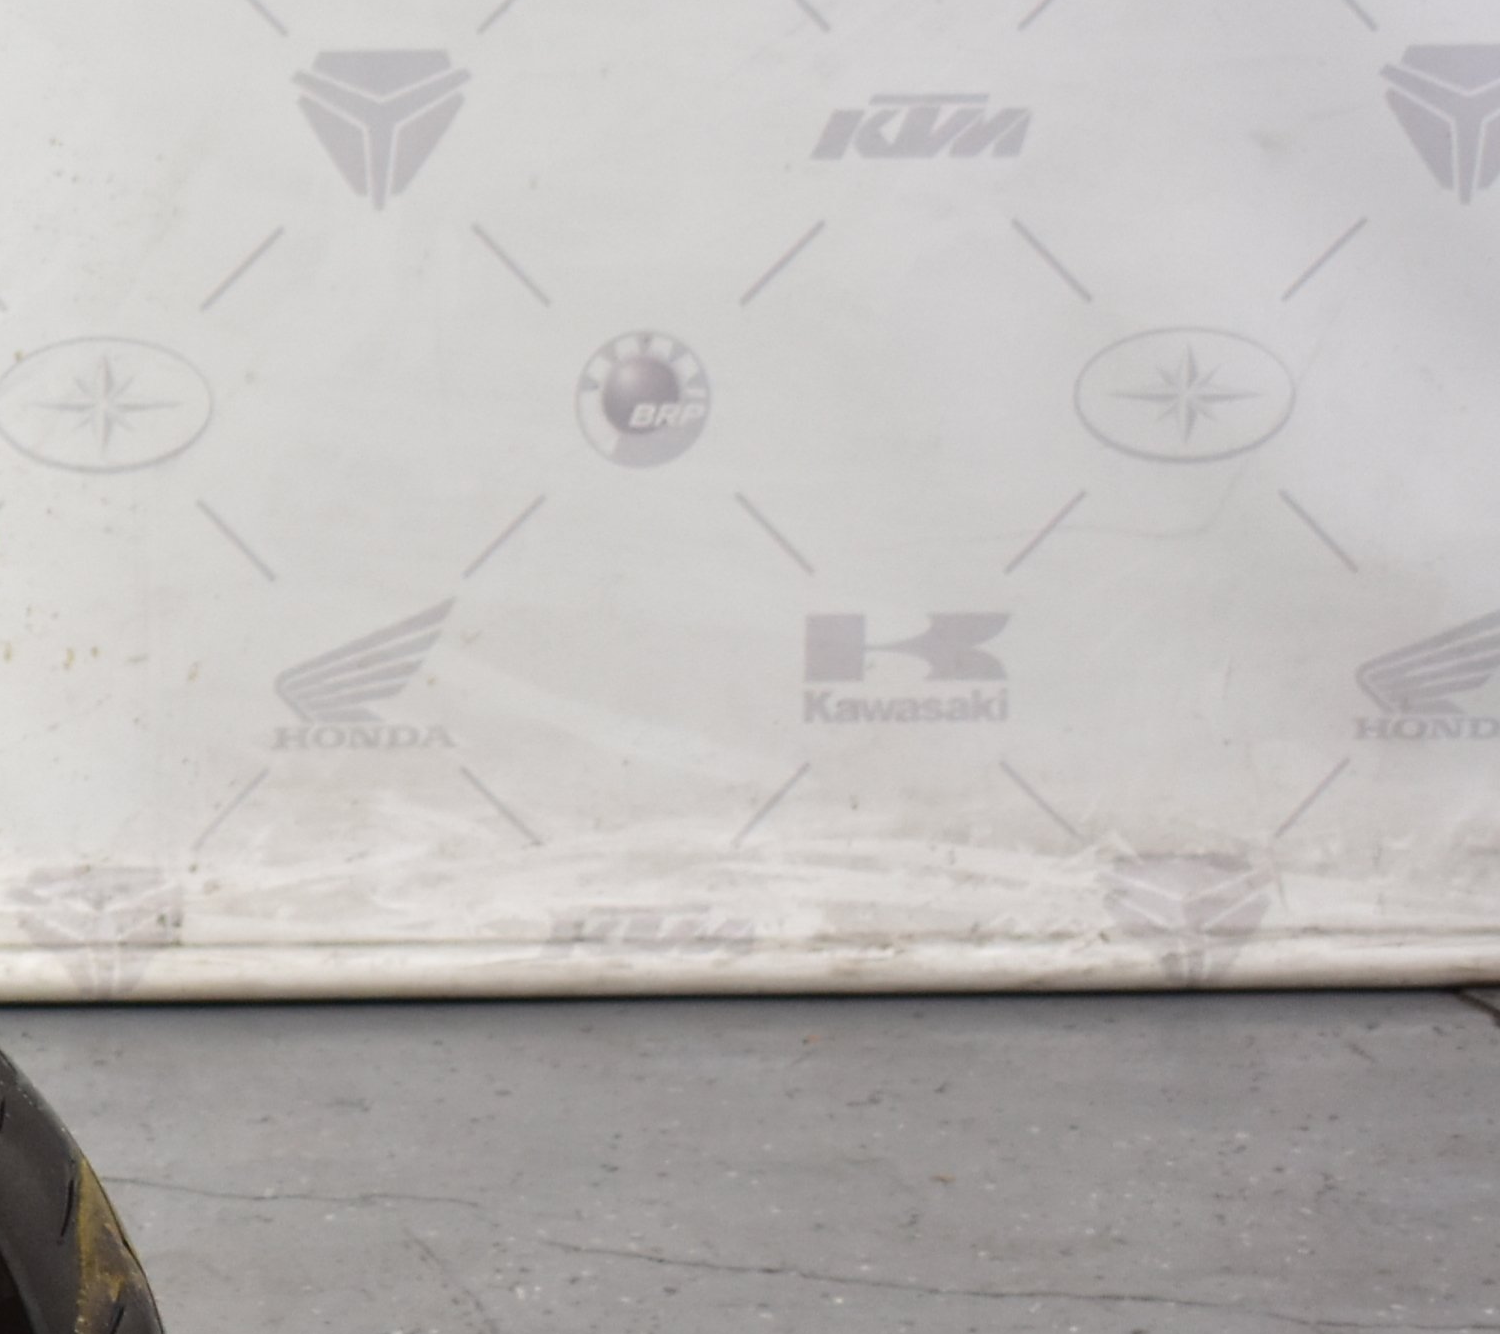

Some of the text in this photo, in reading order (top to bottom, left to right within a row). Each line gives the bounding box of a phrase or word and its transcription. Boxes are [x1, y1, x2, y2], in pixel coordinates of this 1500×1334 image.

[811, 94, 1029, 160] KTM
[629, 405, 708, 430] BRP
[803, 688, 1008, 723] Kawasaki
[271, 725, 455, 751] HONDA
